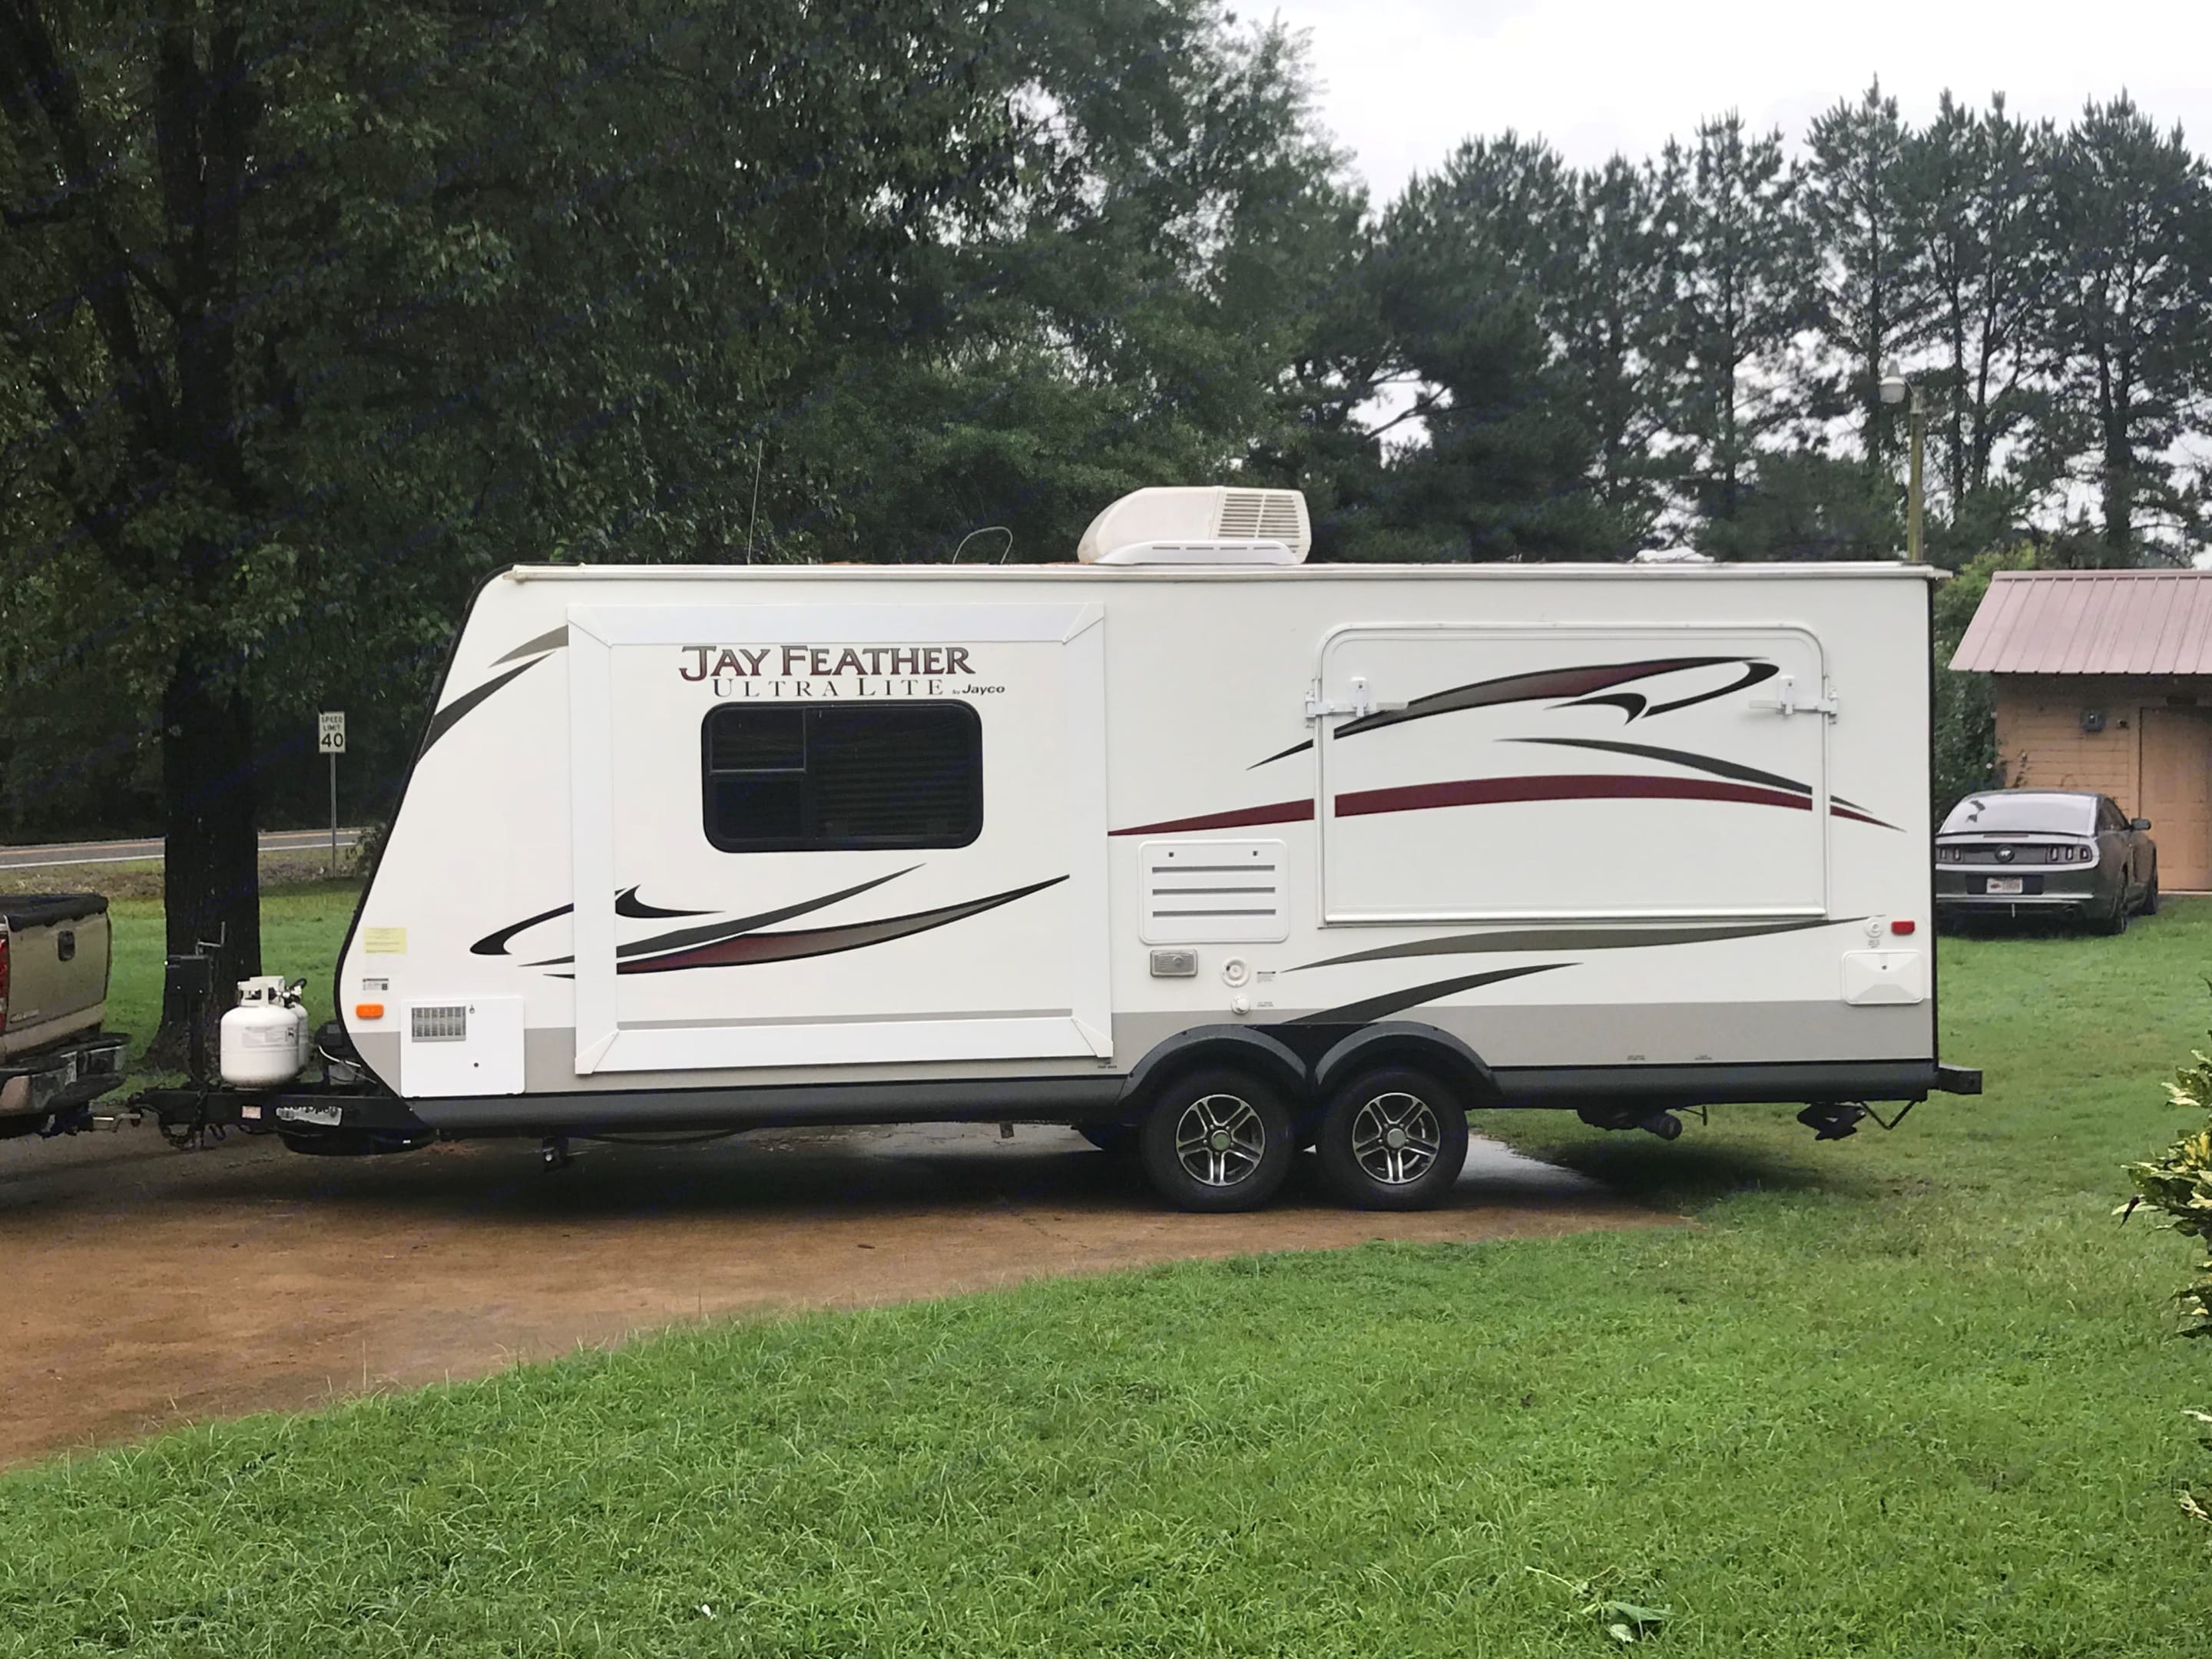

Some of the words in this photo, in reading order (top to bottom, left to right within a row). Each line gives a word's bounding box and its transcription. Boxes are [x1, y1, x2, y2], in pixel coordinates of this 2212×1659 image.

[679, 645, 771, 681] JAY
[780, 645, 976, 677] FEATHER
[713, 677, 839, 697] ULTRA
[856, 677, 944, 697] LITE
[962, 684, 1006, 696] Jayco
[321, 732, 344, 748] 40
